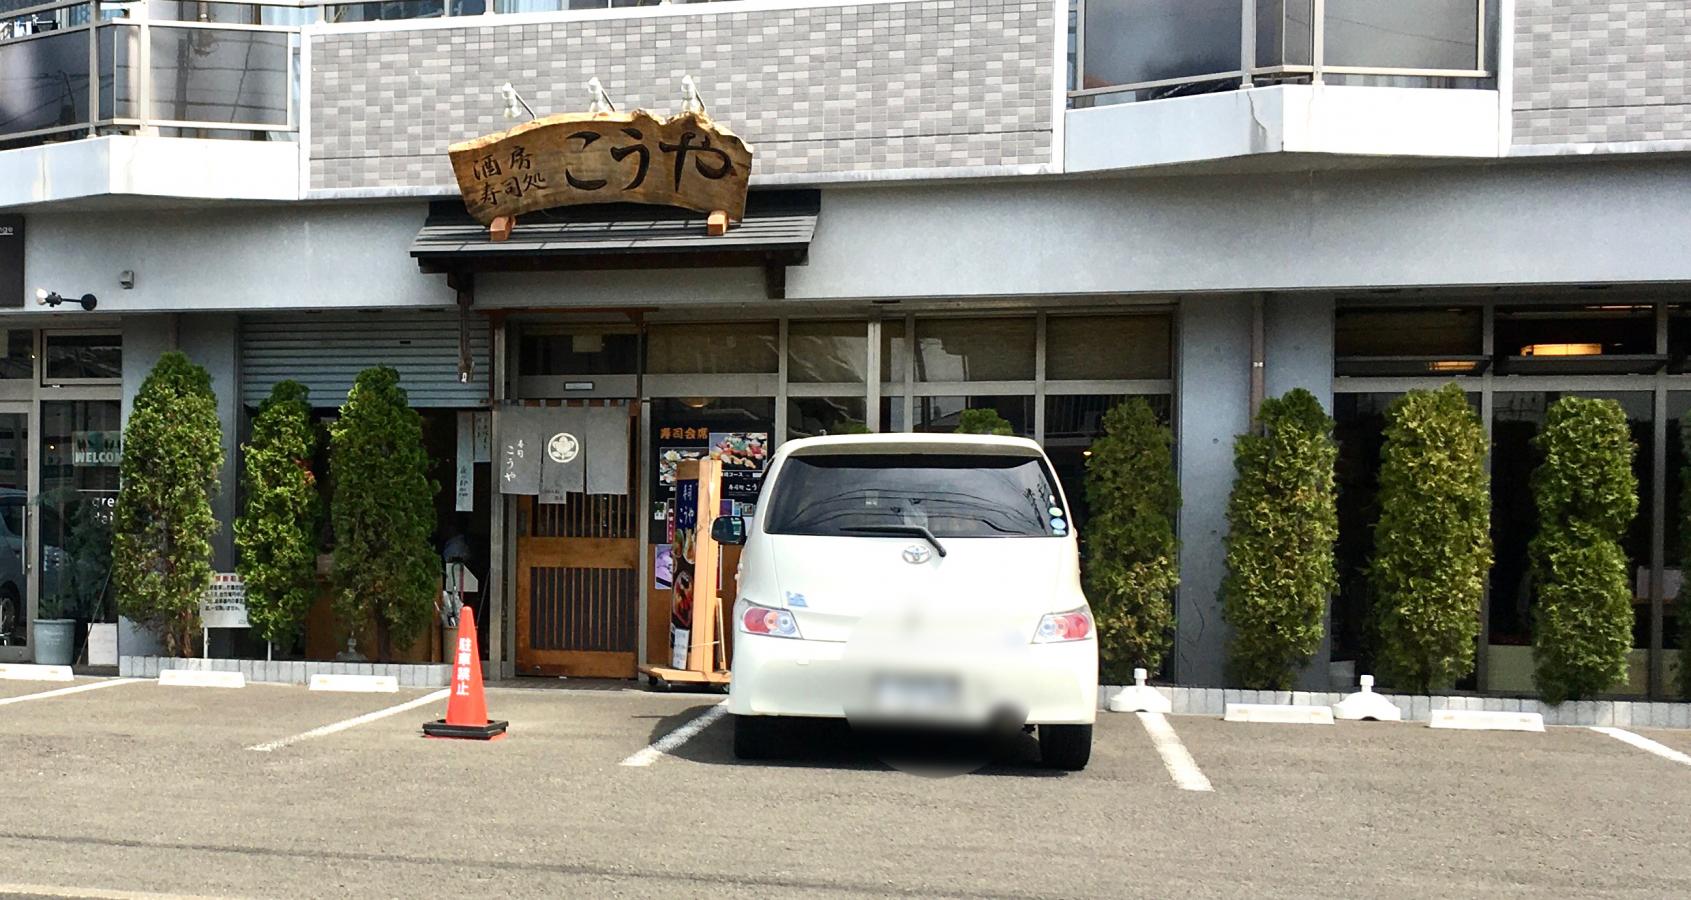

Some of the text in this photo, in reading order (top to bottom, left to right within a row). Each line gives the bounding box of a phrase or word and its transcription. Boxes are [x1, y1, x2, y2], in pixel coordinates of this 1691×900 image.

[472, 145, 533, 182] 酒房
[565, 127, 736, 193] こうや
[479, 173, 547, 206] 寿司処
[660, 428, 708, 439] 寿司会席
[504, 445, 517, 482] こうや
